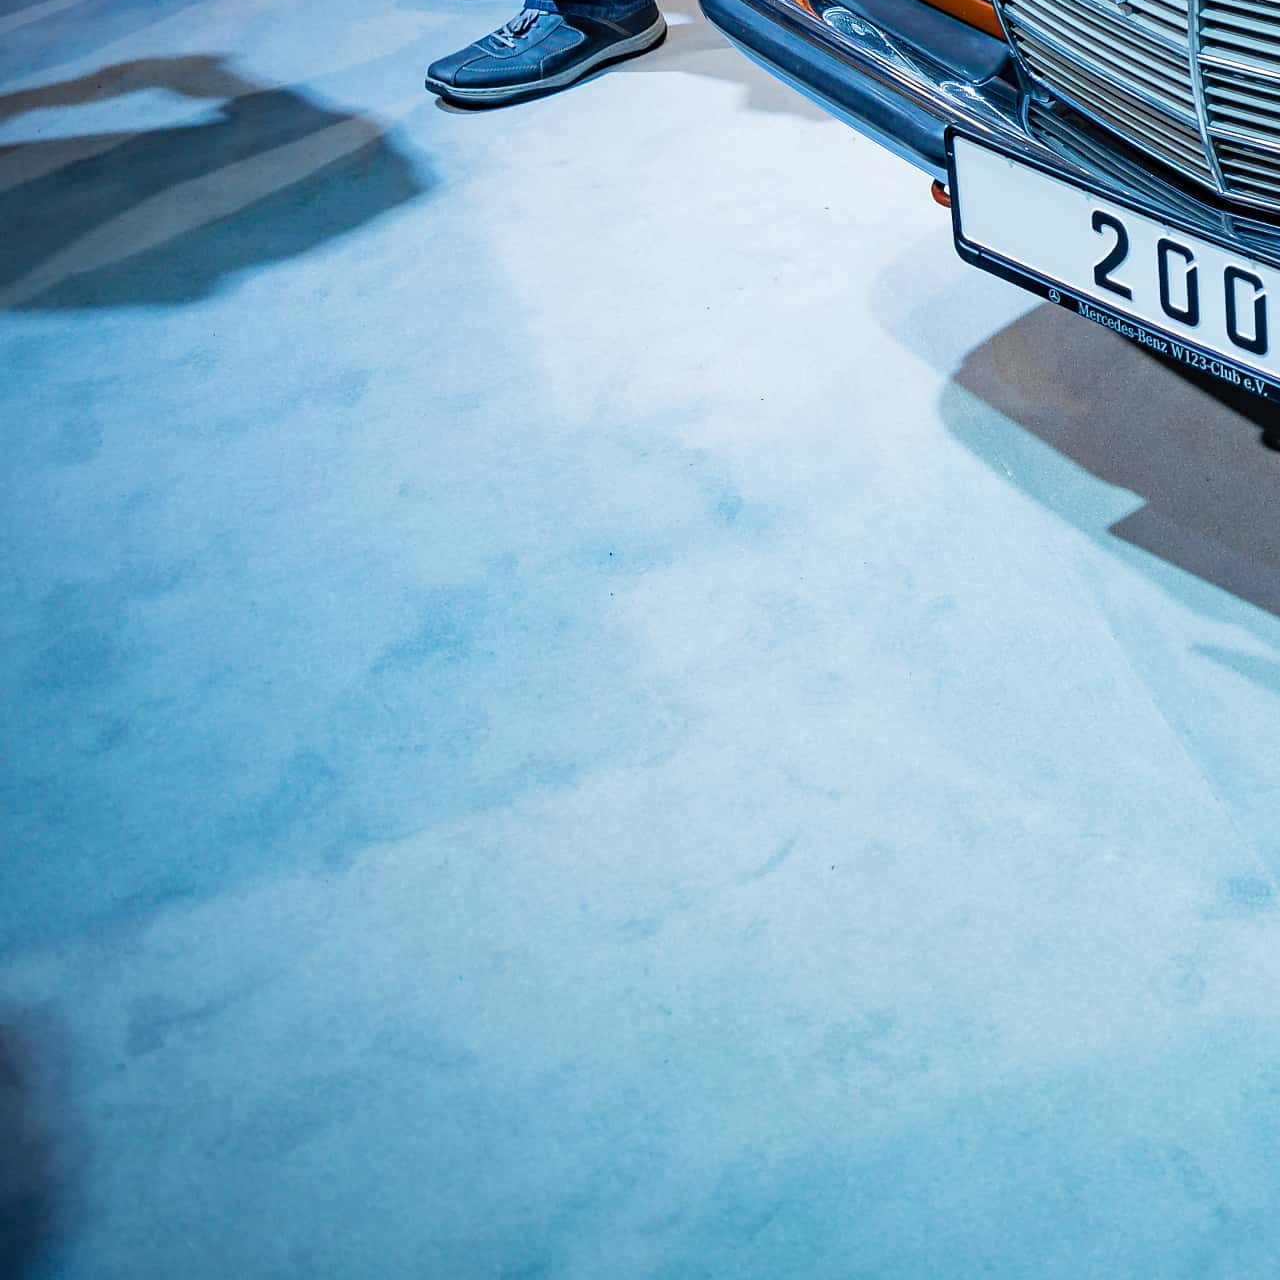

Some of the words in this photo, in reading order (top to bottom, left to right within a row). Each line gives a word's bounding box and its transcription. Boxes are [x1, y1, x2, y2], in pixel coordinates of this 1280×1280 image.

[1091, 209, 1268, 355] 200
[1078, 301, 1167, 353] Mercedes-Benz
[1170, 342, 1241, 386] W123-Club
[1244, 378, 1269, 397] e.V.
